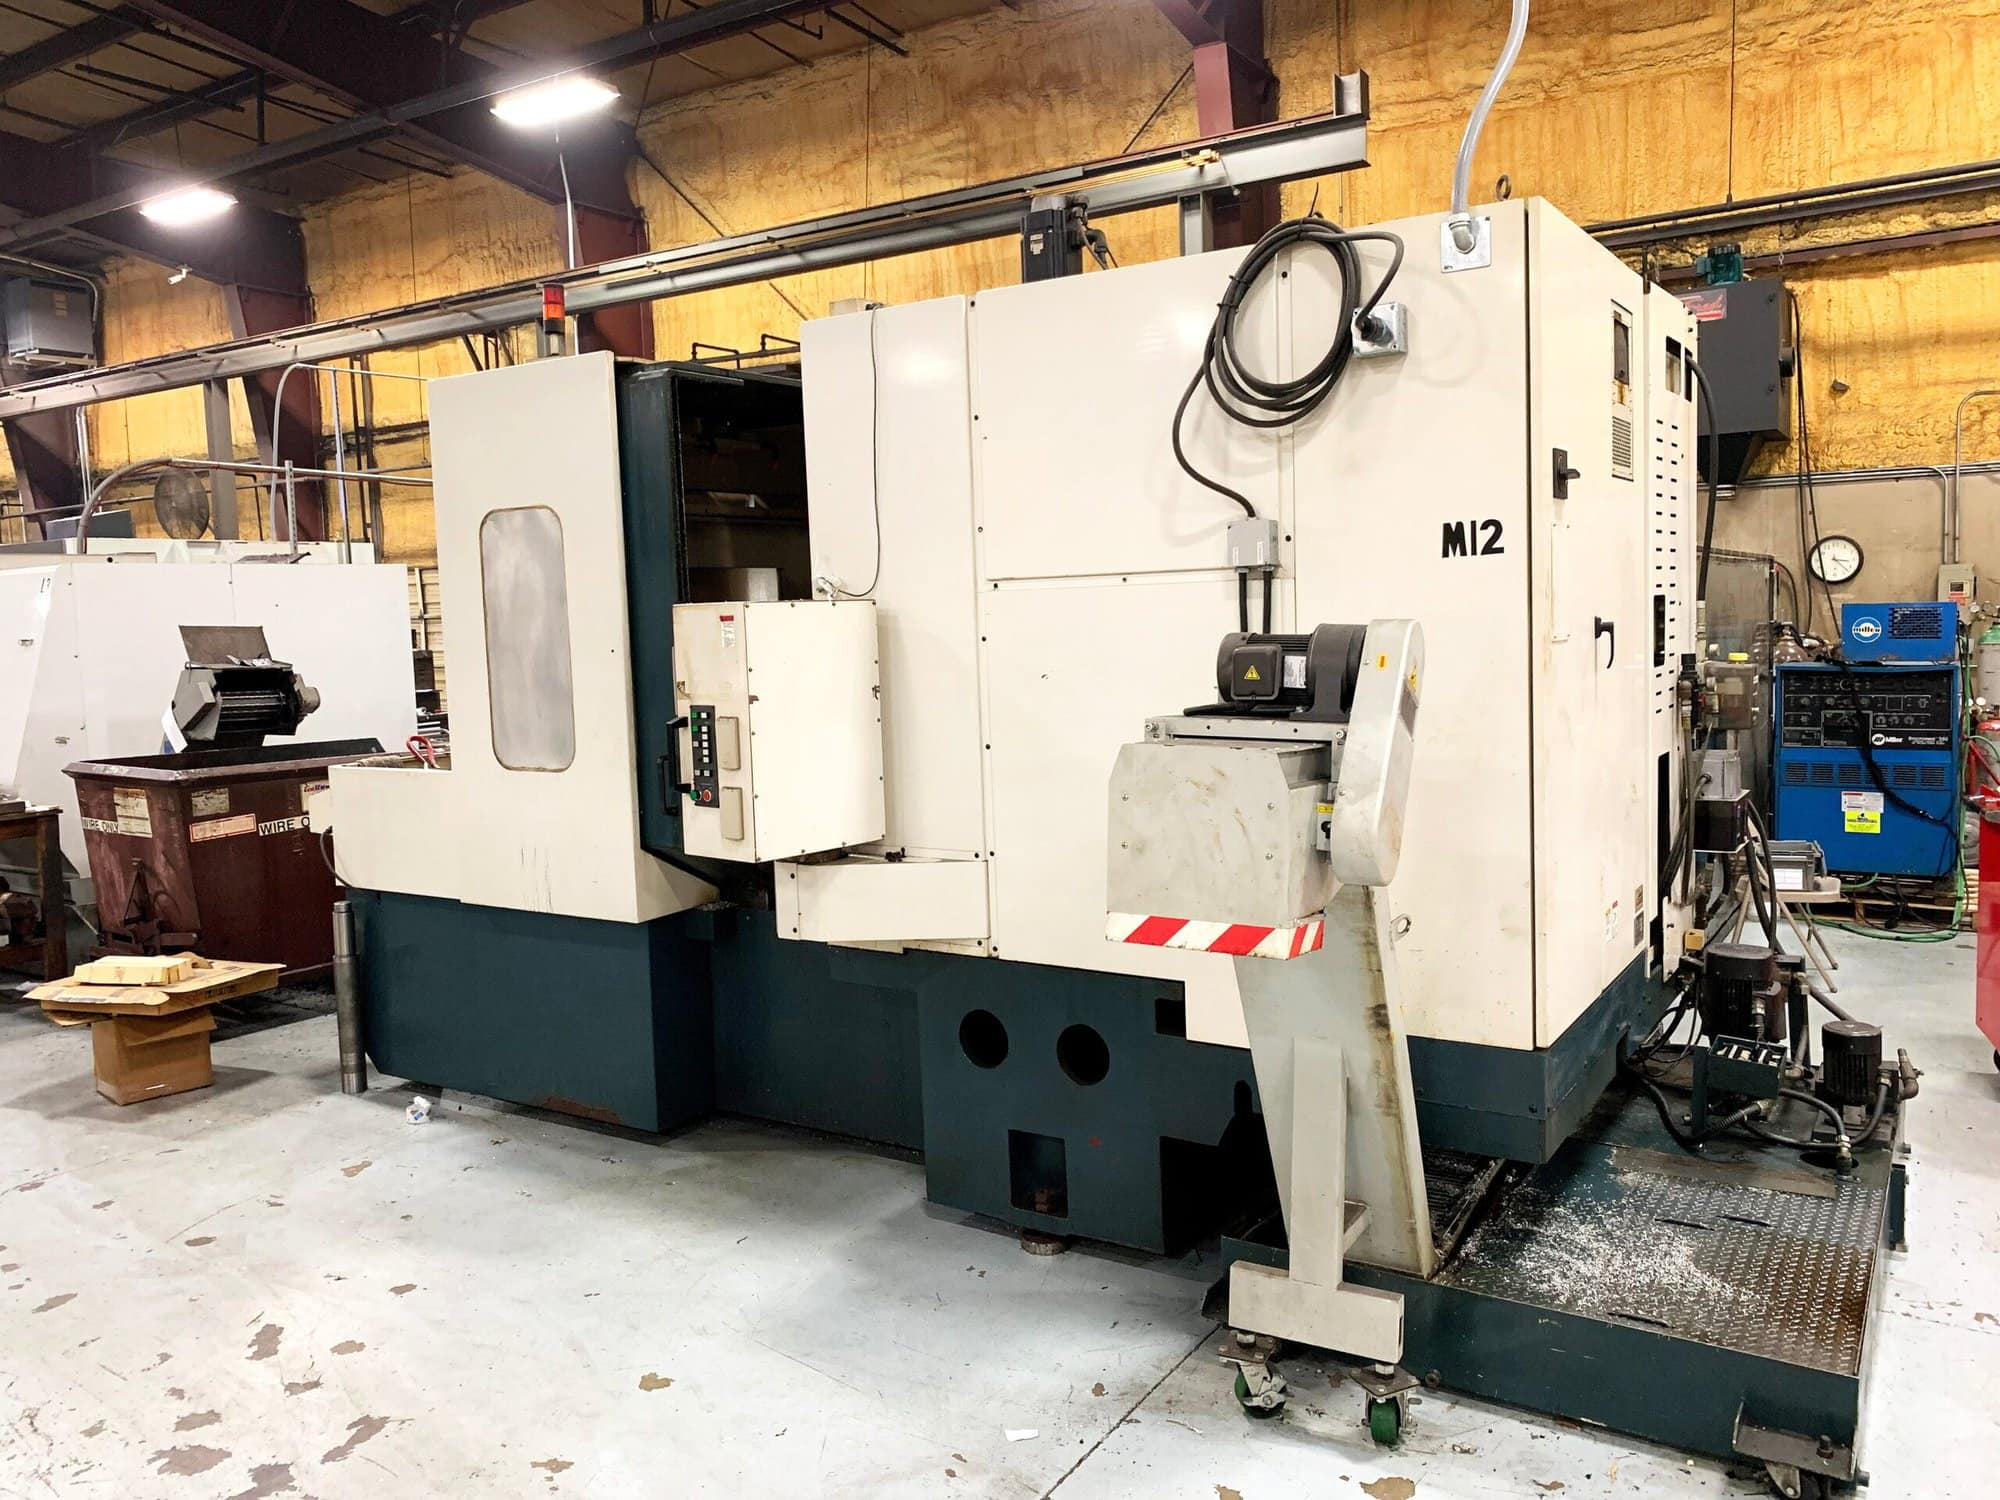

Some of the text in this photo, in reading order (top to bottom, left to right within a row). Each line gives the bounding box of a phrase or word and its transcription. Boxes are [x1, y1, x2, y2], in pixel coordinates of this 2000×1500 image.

[1441, 518, 1505, 558] M12
[82, 817, 119, 833] WIRE ONLY
[260, 818, 295, 835] WIRE
